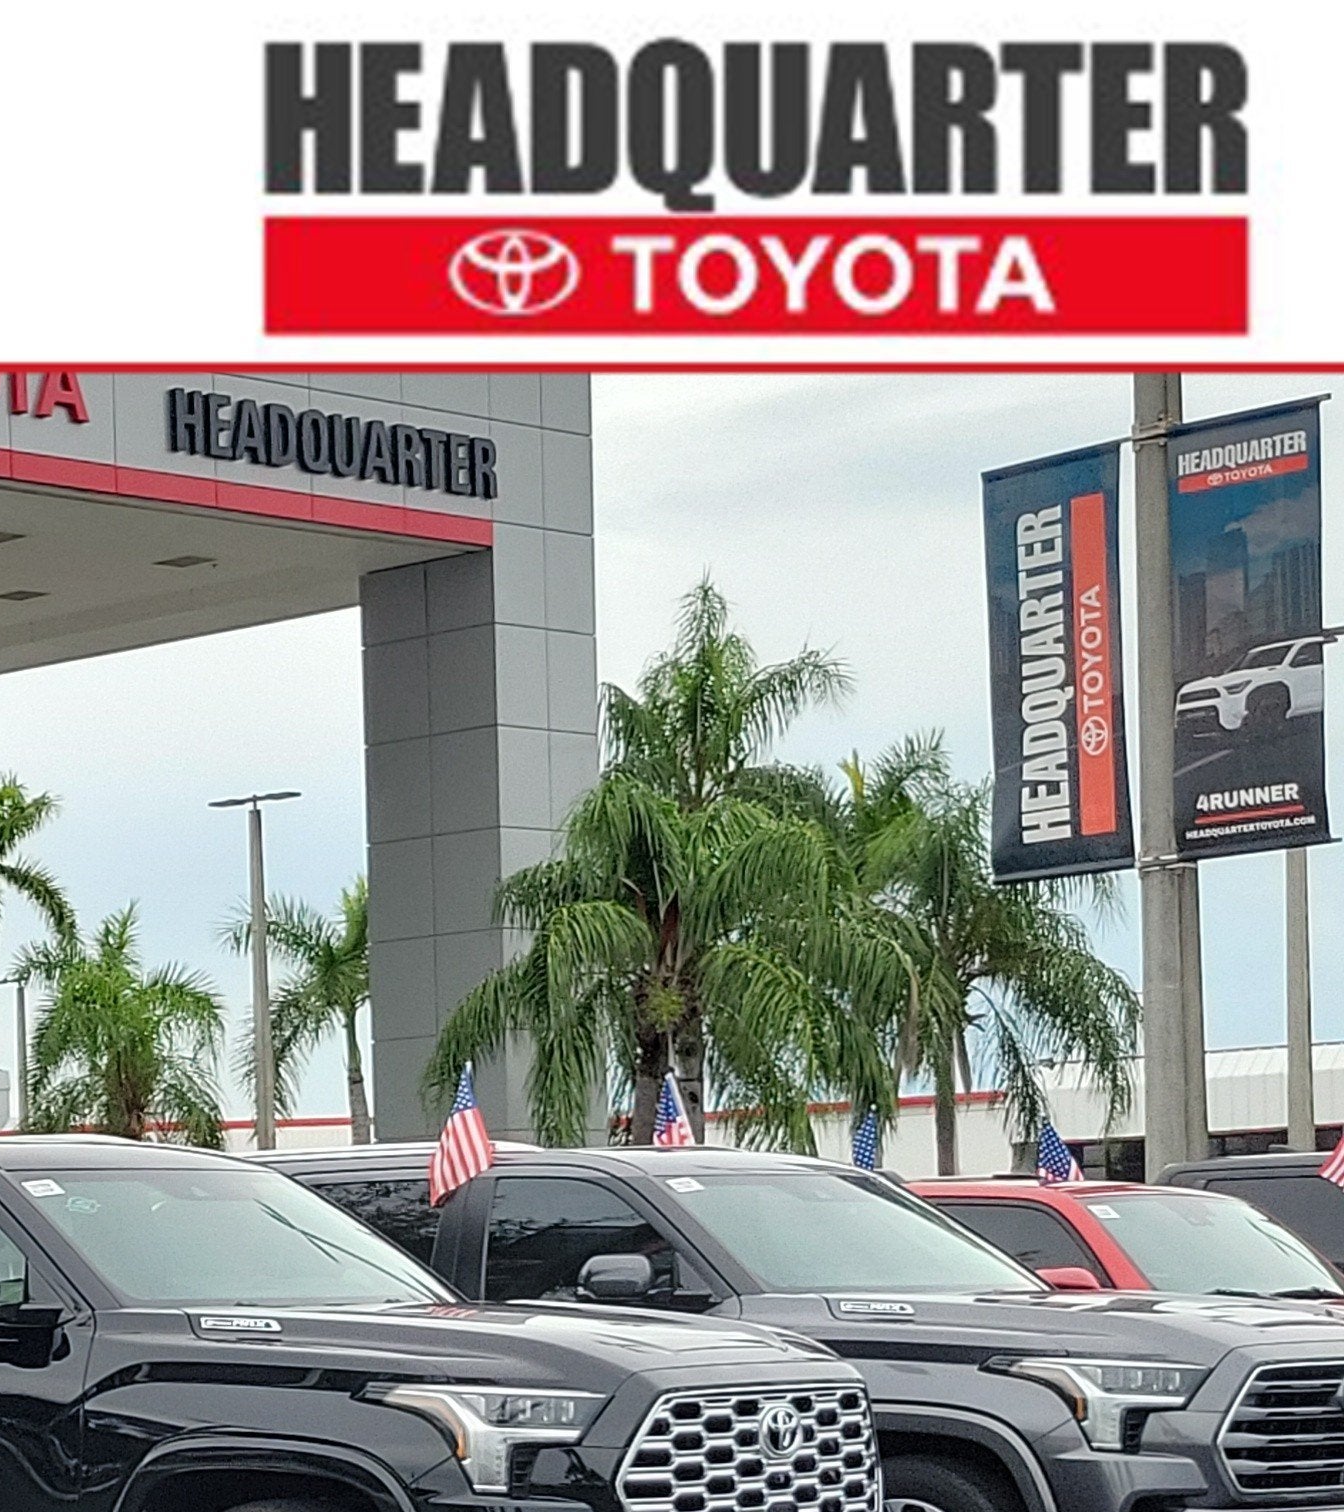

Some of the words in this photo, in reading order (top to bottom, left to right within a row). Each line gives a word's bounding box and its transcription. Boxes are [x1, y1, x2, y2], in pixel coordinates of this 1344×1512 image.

[165, 387, 498, 500] HEADQUARTER
[1179, 430, 1307, 477] HEADQUARTER
[1224, 464, 1273, 481] TOYOTA
[1079, 585, 1104, 714] TOYOTA
[1016, 504, 1072, 844] HEADQUARTER
[1196, 783, 1300, 812] 4RUNNER
[1185, 815, 1316, 840] HEADQUARTERTOYOTA.COM
